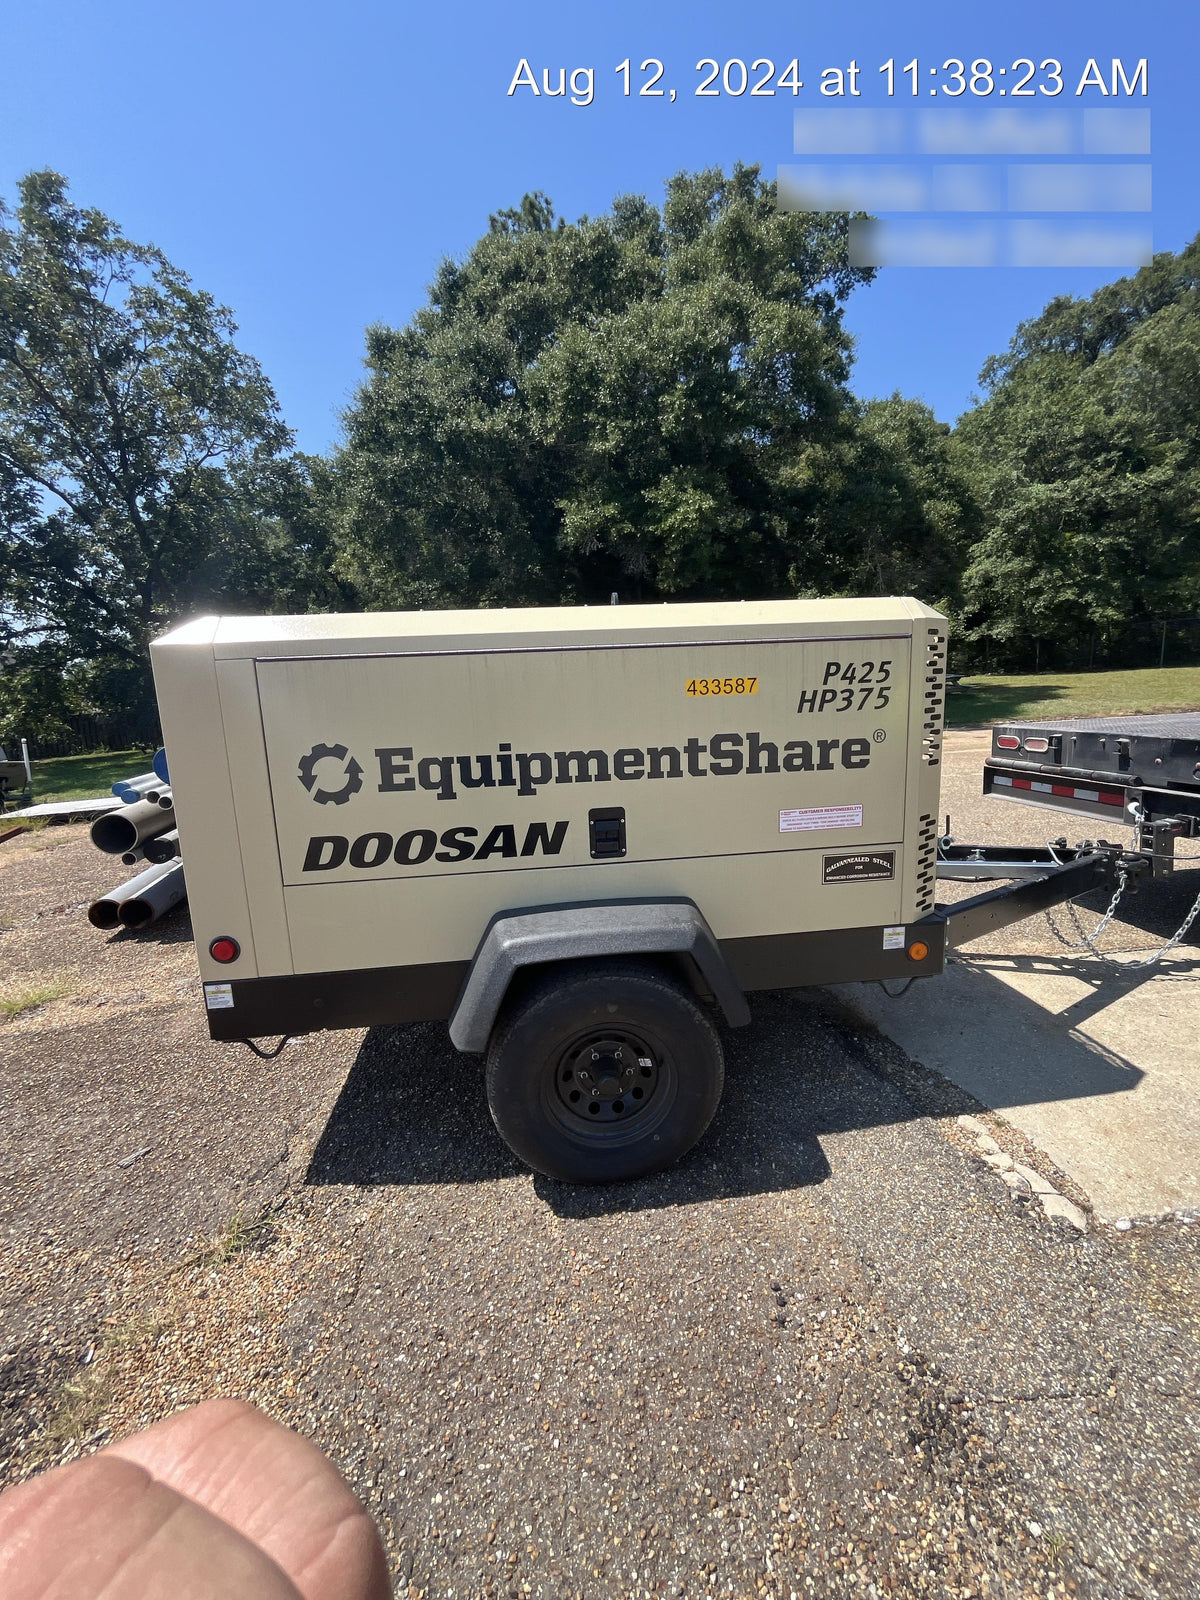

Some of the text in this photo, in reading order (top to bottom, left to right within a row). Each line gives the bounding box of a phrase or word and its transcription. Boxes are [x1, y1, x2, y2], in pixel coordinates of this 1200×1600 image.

[822, 660, 892, 686] P425
[687, 677, 757, 696] 433587
[797, 686, 891, 713] HP375
[302, 820, 570, 872] DOOSAN
[872, 857, 892, 869] STEEL
